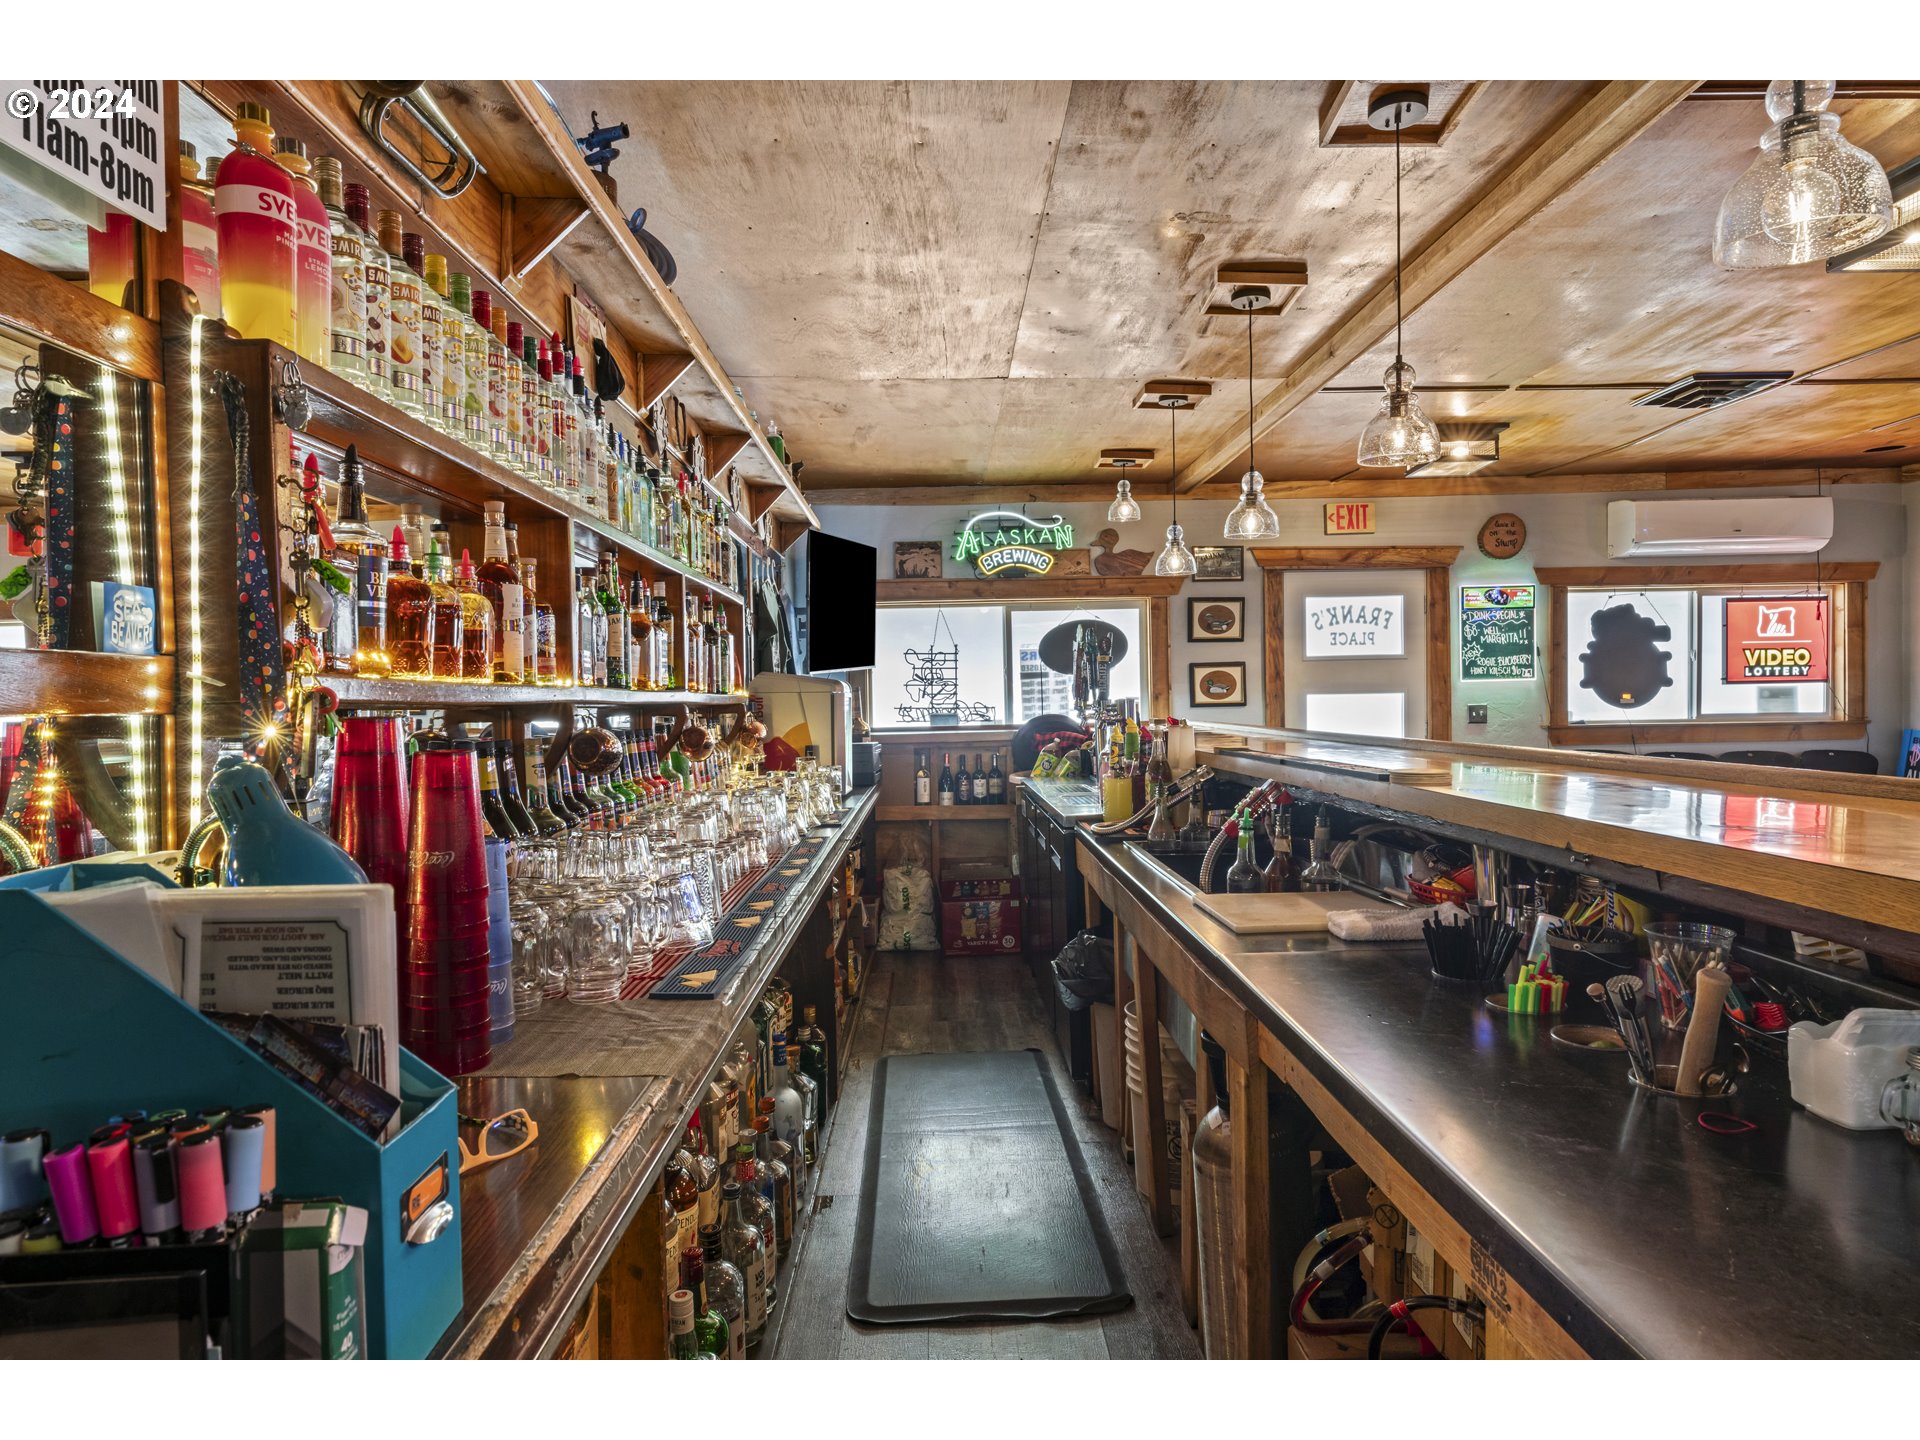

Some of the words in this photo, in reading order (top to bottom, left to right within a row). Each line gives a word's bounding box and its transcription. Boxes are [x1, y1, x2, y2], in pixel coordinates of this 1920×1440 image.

[22, 101, 154, 213] 11am-8pm
[1336, 504, 1369, 530] EXIT
[956, 525, 1073, 560] ALASKAN
[983, 549, 1049, 570] BREWING
[1743, 648, 1811, 666] VIDEO
[1745, 666, 1809, 676] LOTTERY
[278, 972, 302, 980] MELT
[277, 987, 314, 995] BURGER
[272, 1001, 309, 1009] BURGER
